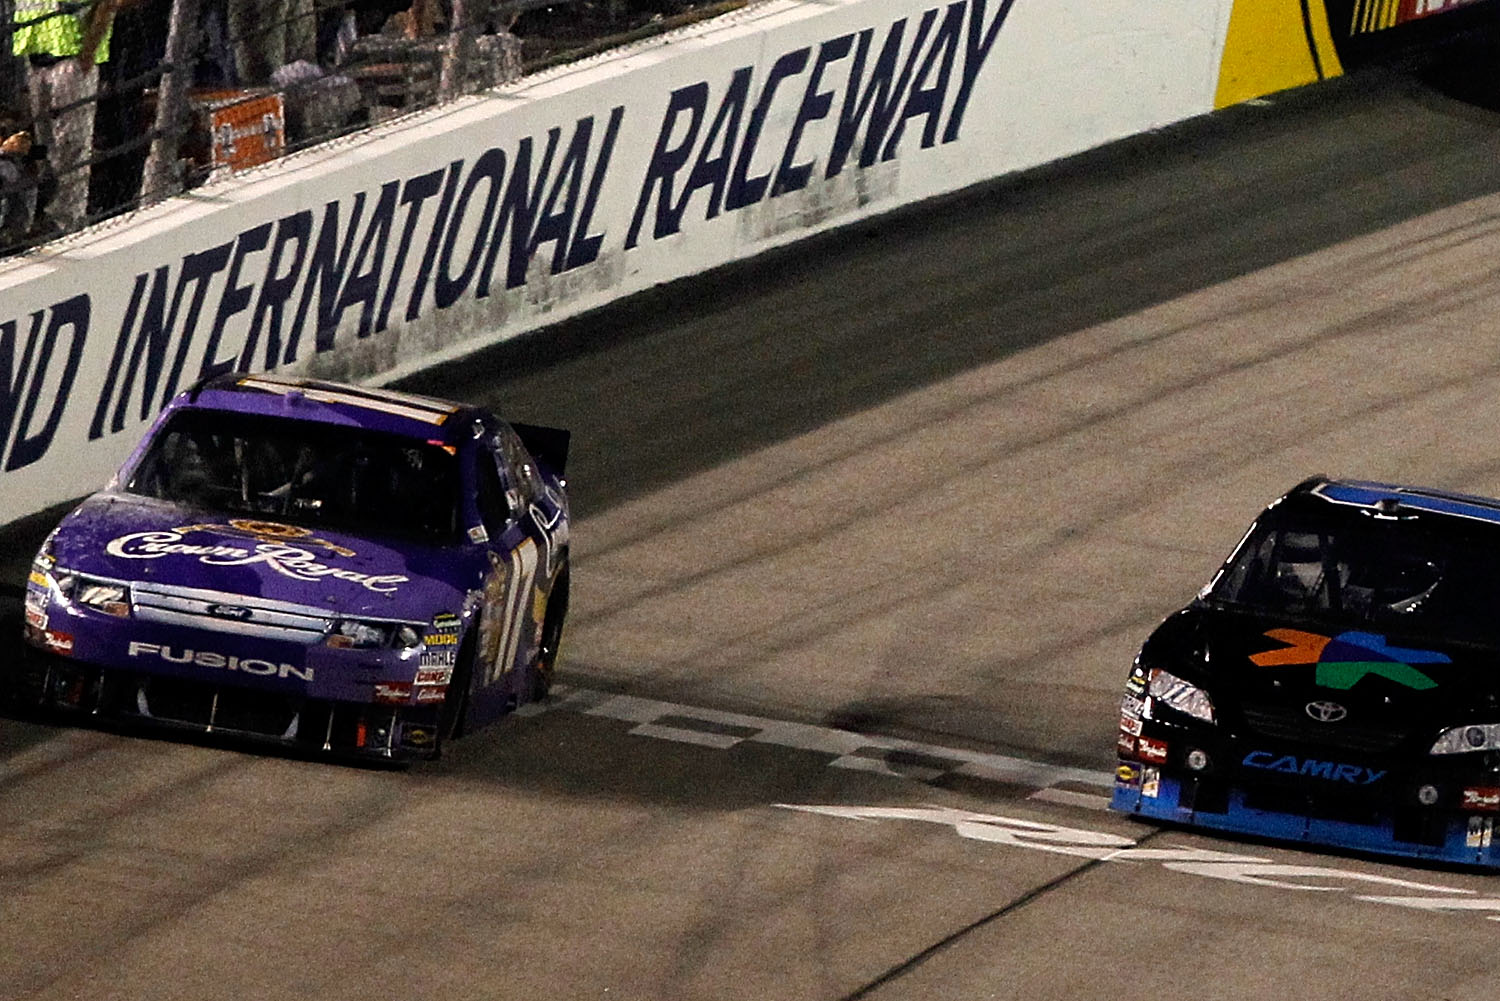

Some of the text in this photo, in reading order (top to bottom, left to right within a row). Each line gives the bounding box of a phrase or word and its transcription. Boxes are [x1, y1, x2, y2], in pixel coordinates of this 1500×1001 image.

[88, 105, 625, 442] INTERNATIONAL
[106, 531, 409, 592] Crown Royal
[128, 641, 315, 682] FUSION
[1242, 750, 1388, 785] CAMRY
